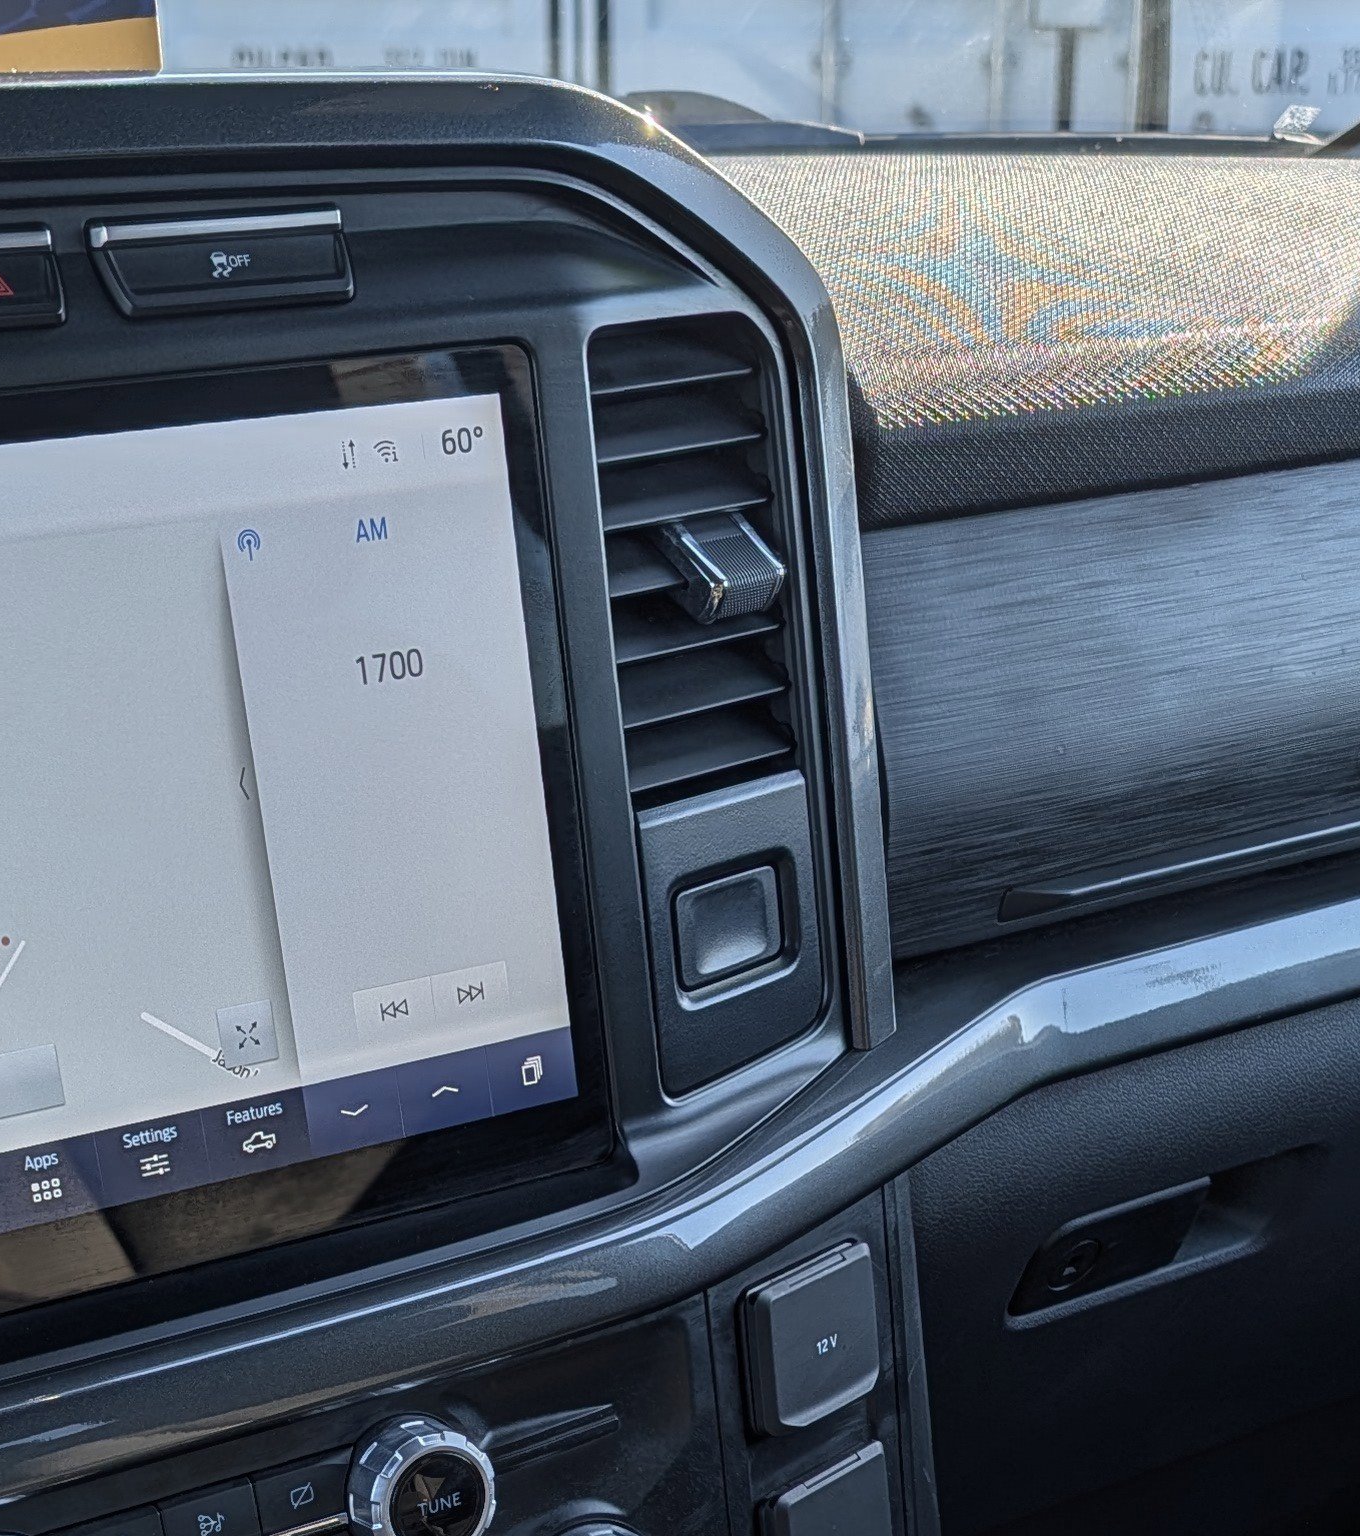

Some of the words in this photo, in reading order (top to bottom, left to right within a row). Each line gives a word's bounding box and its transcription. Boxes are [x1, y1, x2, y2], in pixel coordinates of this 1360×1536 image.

[228, 254, 251, 268] OFF
[355, 517, 389, 543] AM
[355, 648, 423, 685] 1700
[226, 1100, 283, 1126] Features
[122, 1124, 179, 1149] Settings
[24, 1151, 59, 1172] Apps
[417, 1491, 462, 1517] TUNE
